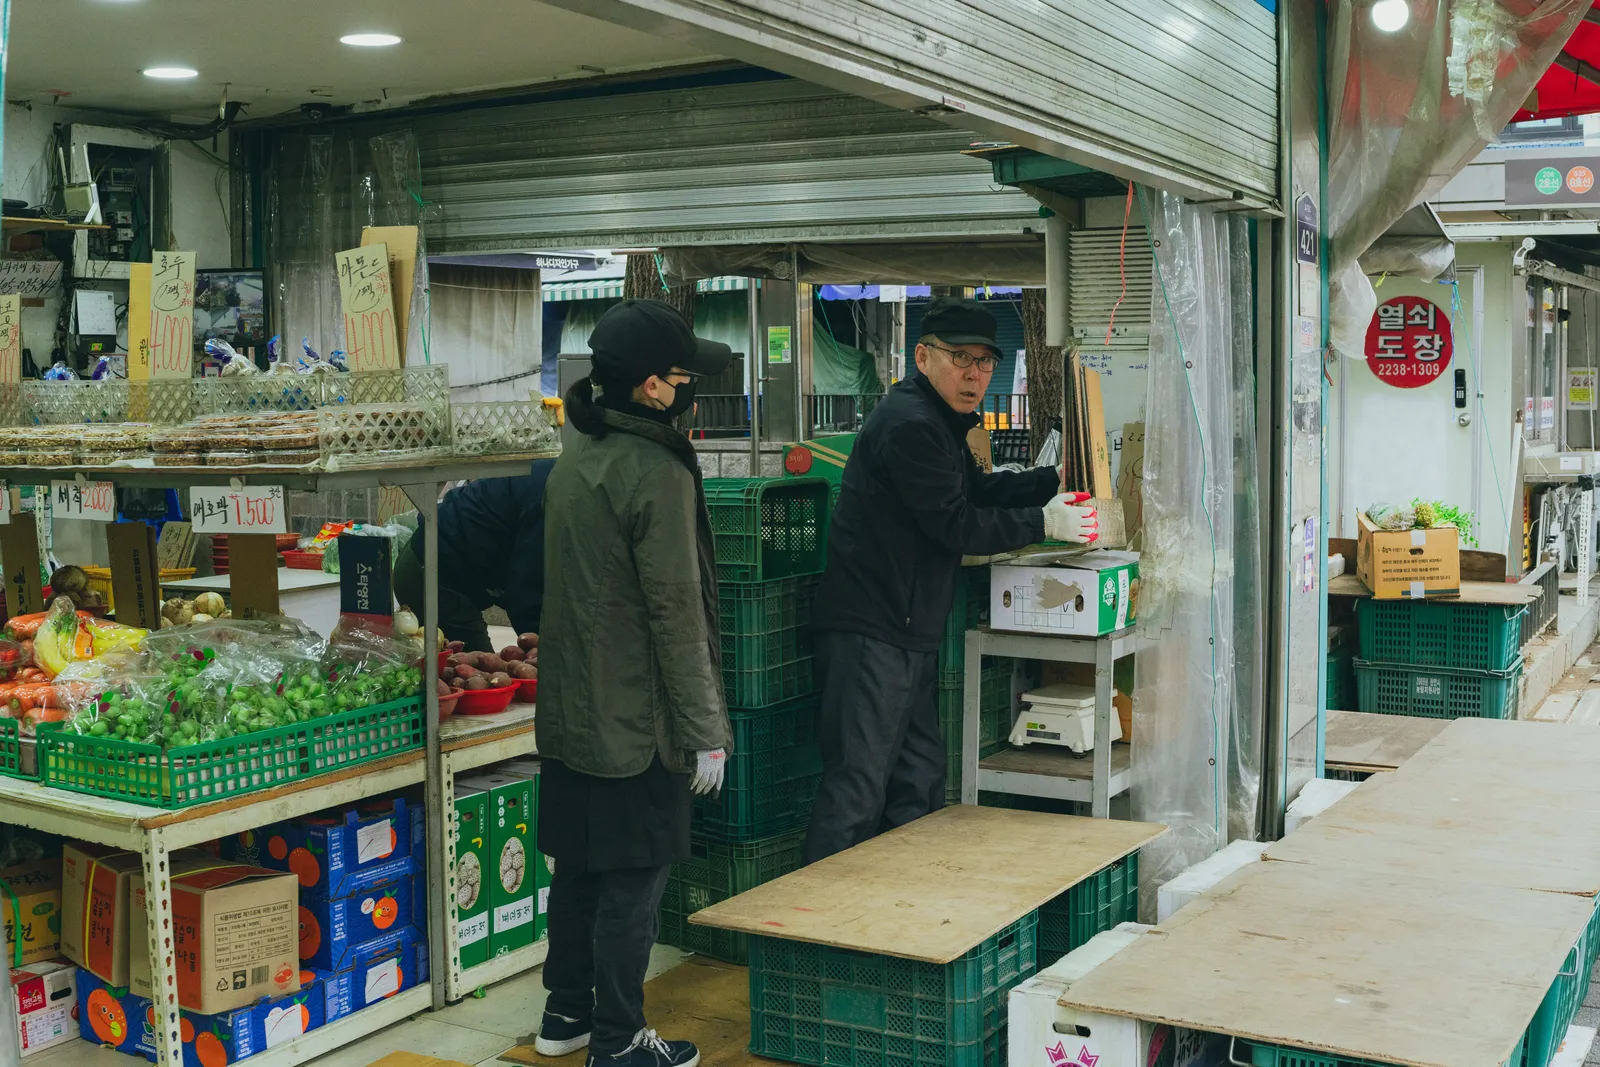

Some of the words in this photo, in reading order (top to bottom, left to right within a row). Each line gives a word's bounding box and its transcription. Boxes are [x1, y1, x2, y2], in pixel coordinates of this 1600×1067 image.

[1538, 178, 1560, 189] 2호선
[1300, 229, 1315, 256] 421
[341, 256, 386, 287] 아몬드
[1377, 303, 1436, 331] 열쇠
[1374, 334, 1446, 362] 도장
[1378, 363, 1440, 376] 2238-1309
[193, 497, 229, 527] 애호박
[501, 904, 532, 923] 표고버섯
